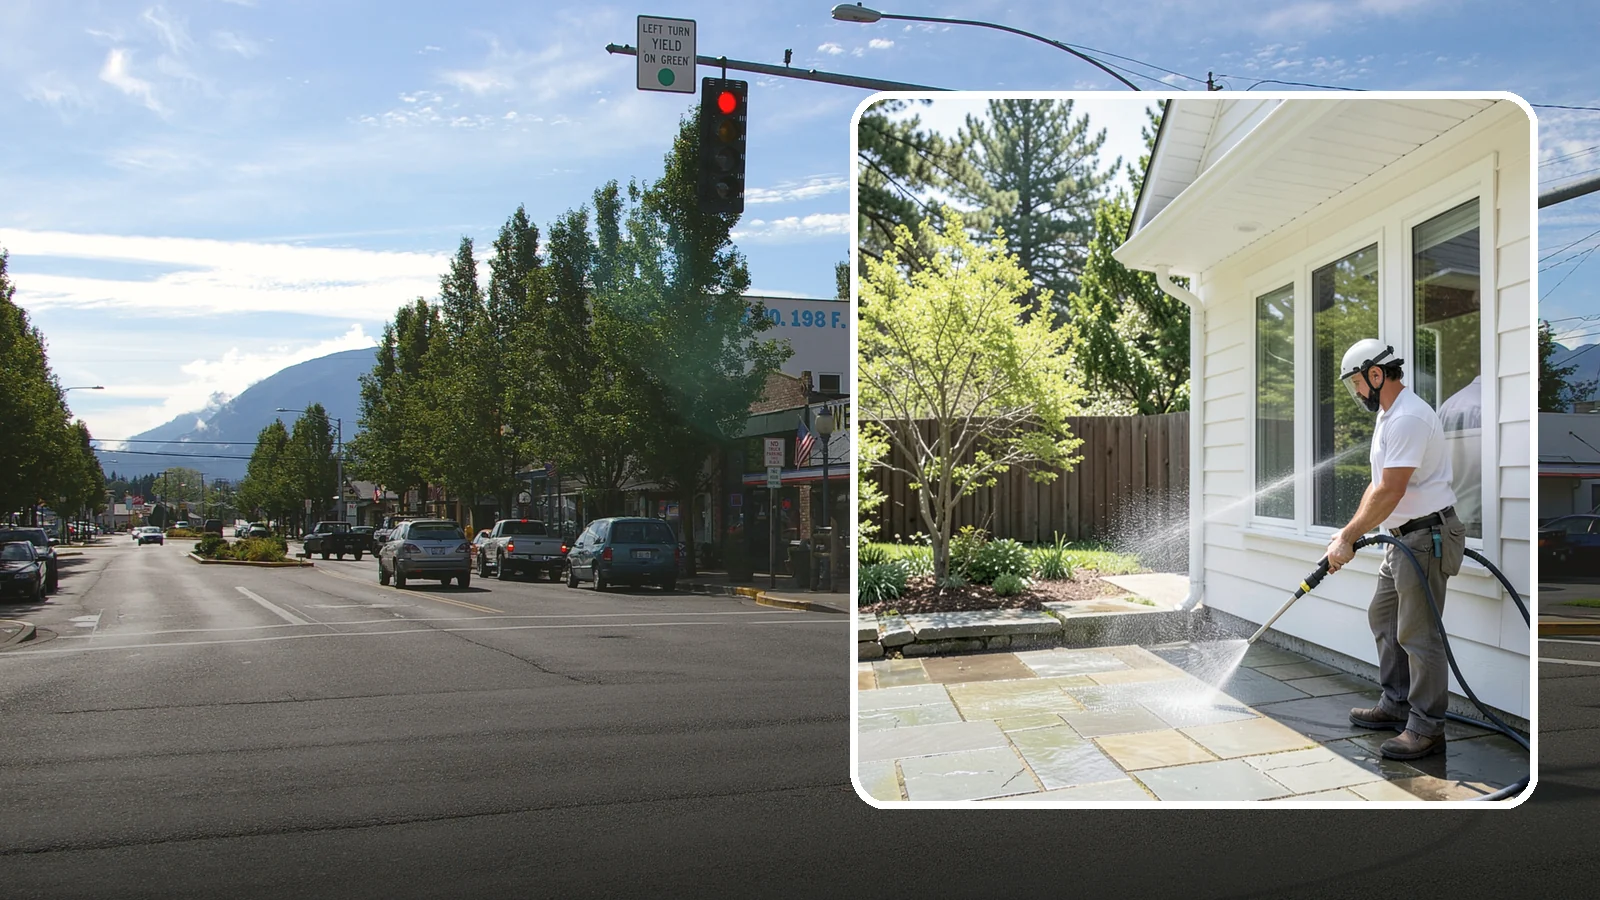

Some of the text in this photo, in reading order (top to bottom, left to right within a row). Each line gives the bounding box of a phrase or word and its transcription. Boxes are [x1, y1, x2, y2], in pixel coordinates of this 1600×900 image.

[643, 24, 690, 36] LEFT TURN
[652, 38, 682, 51] YIELD
[791, 310, 826, 328] 198
[831, 311, 847, 329] F.
